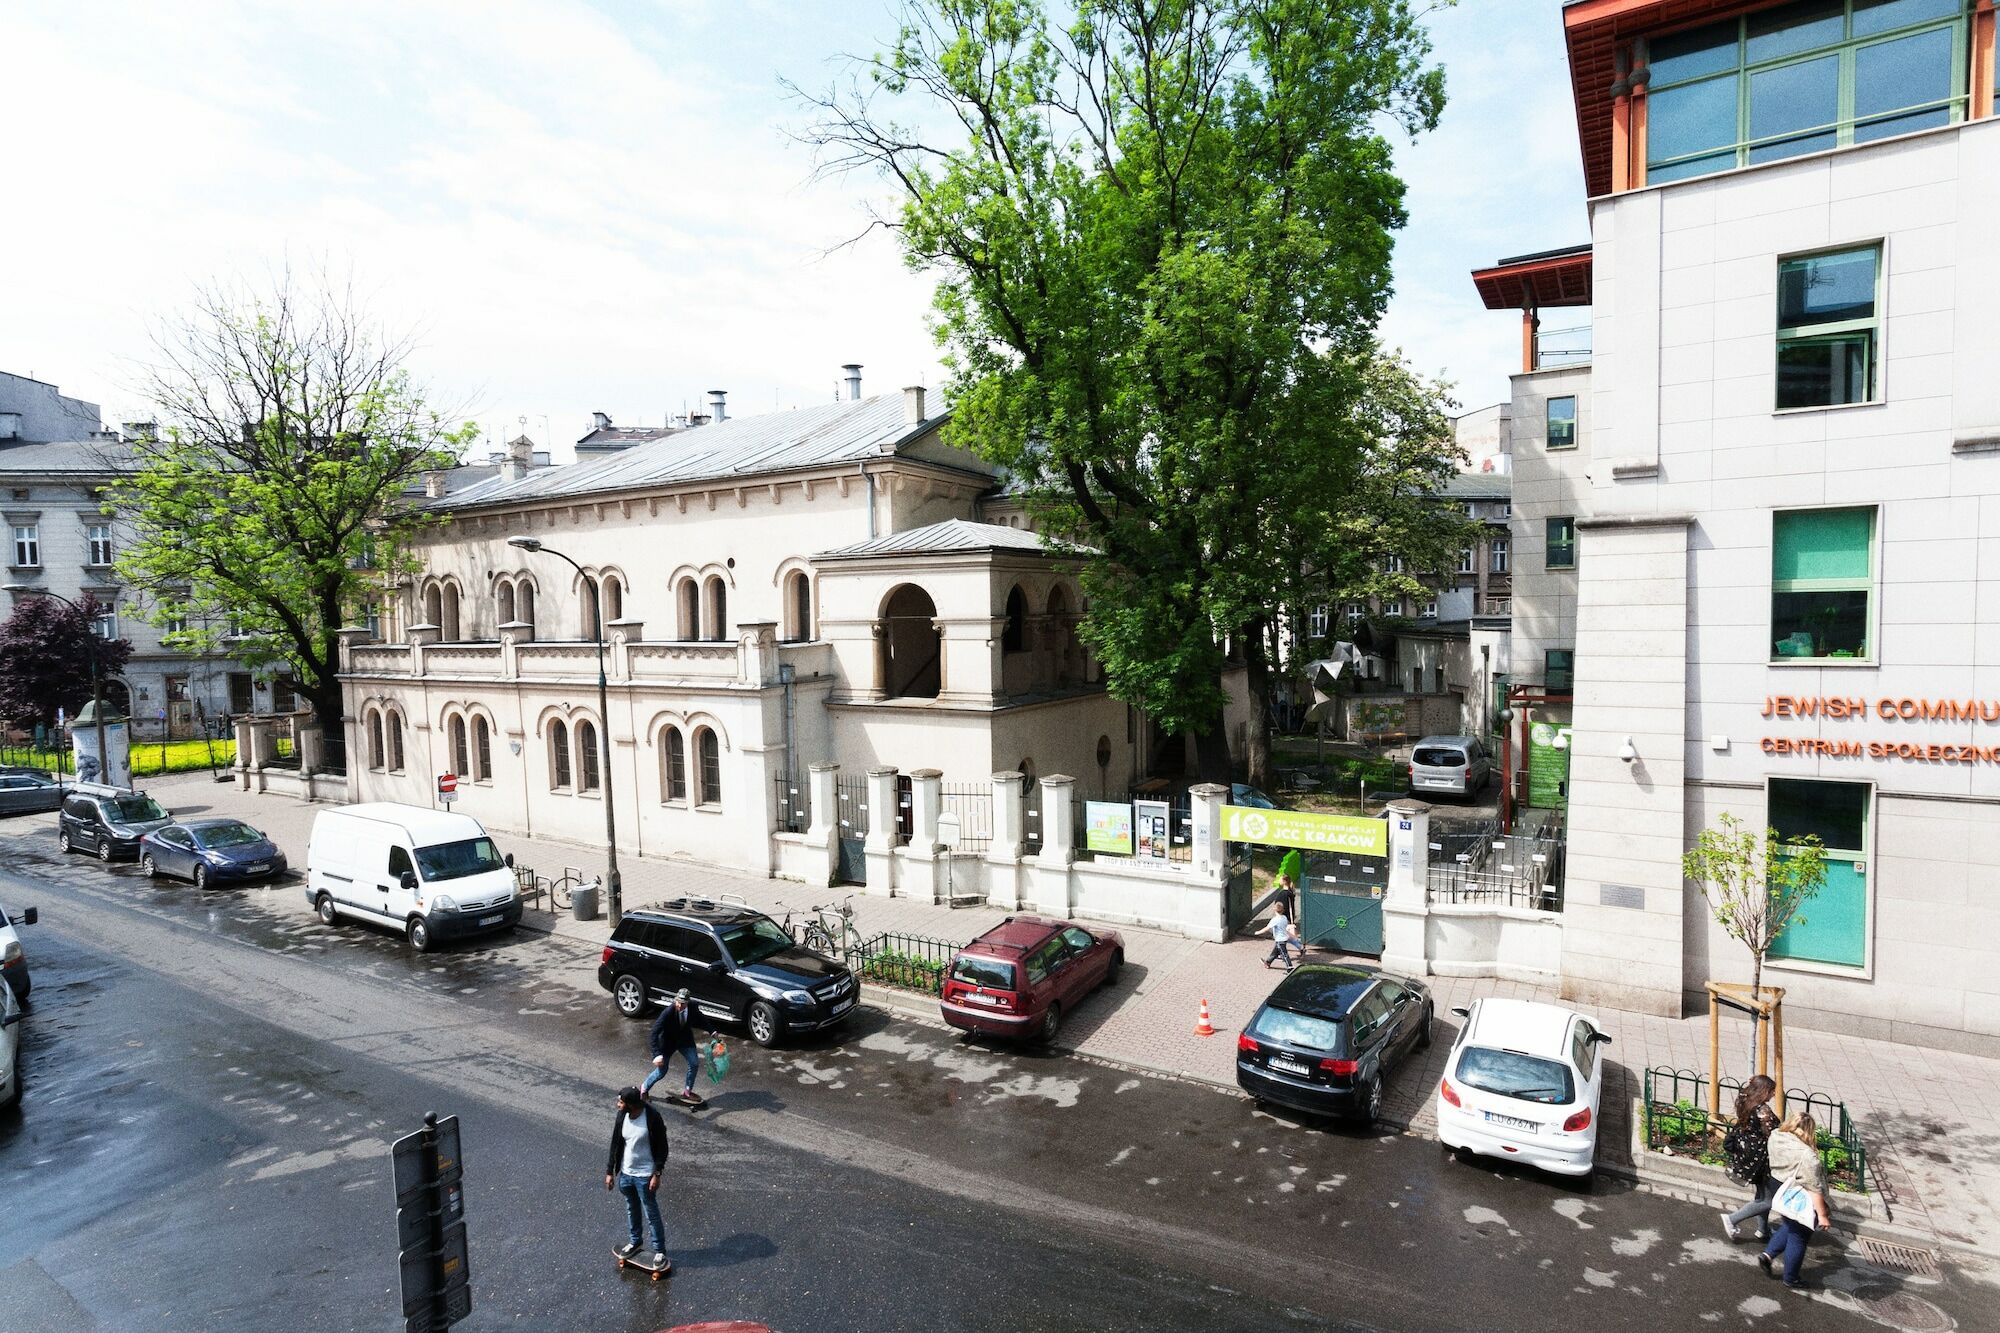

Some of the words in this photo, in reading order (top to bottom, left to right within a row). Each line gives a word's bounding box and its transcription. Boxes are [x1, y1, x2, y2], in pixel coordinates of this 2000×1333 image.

[1760, 696, 1866, 718] JEWISH
[1760, 736, 1861, 757] CENTRUM
[1273, 828, 1300, 841] JCC
